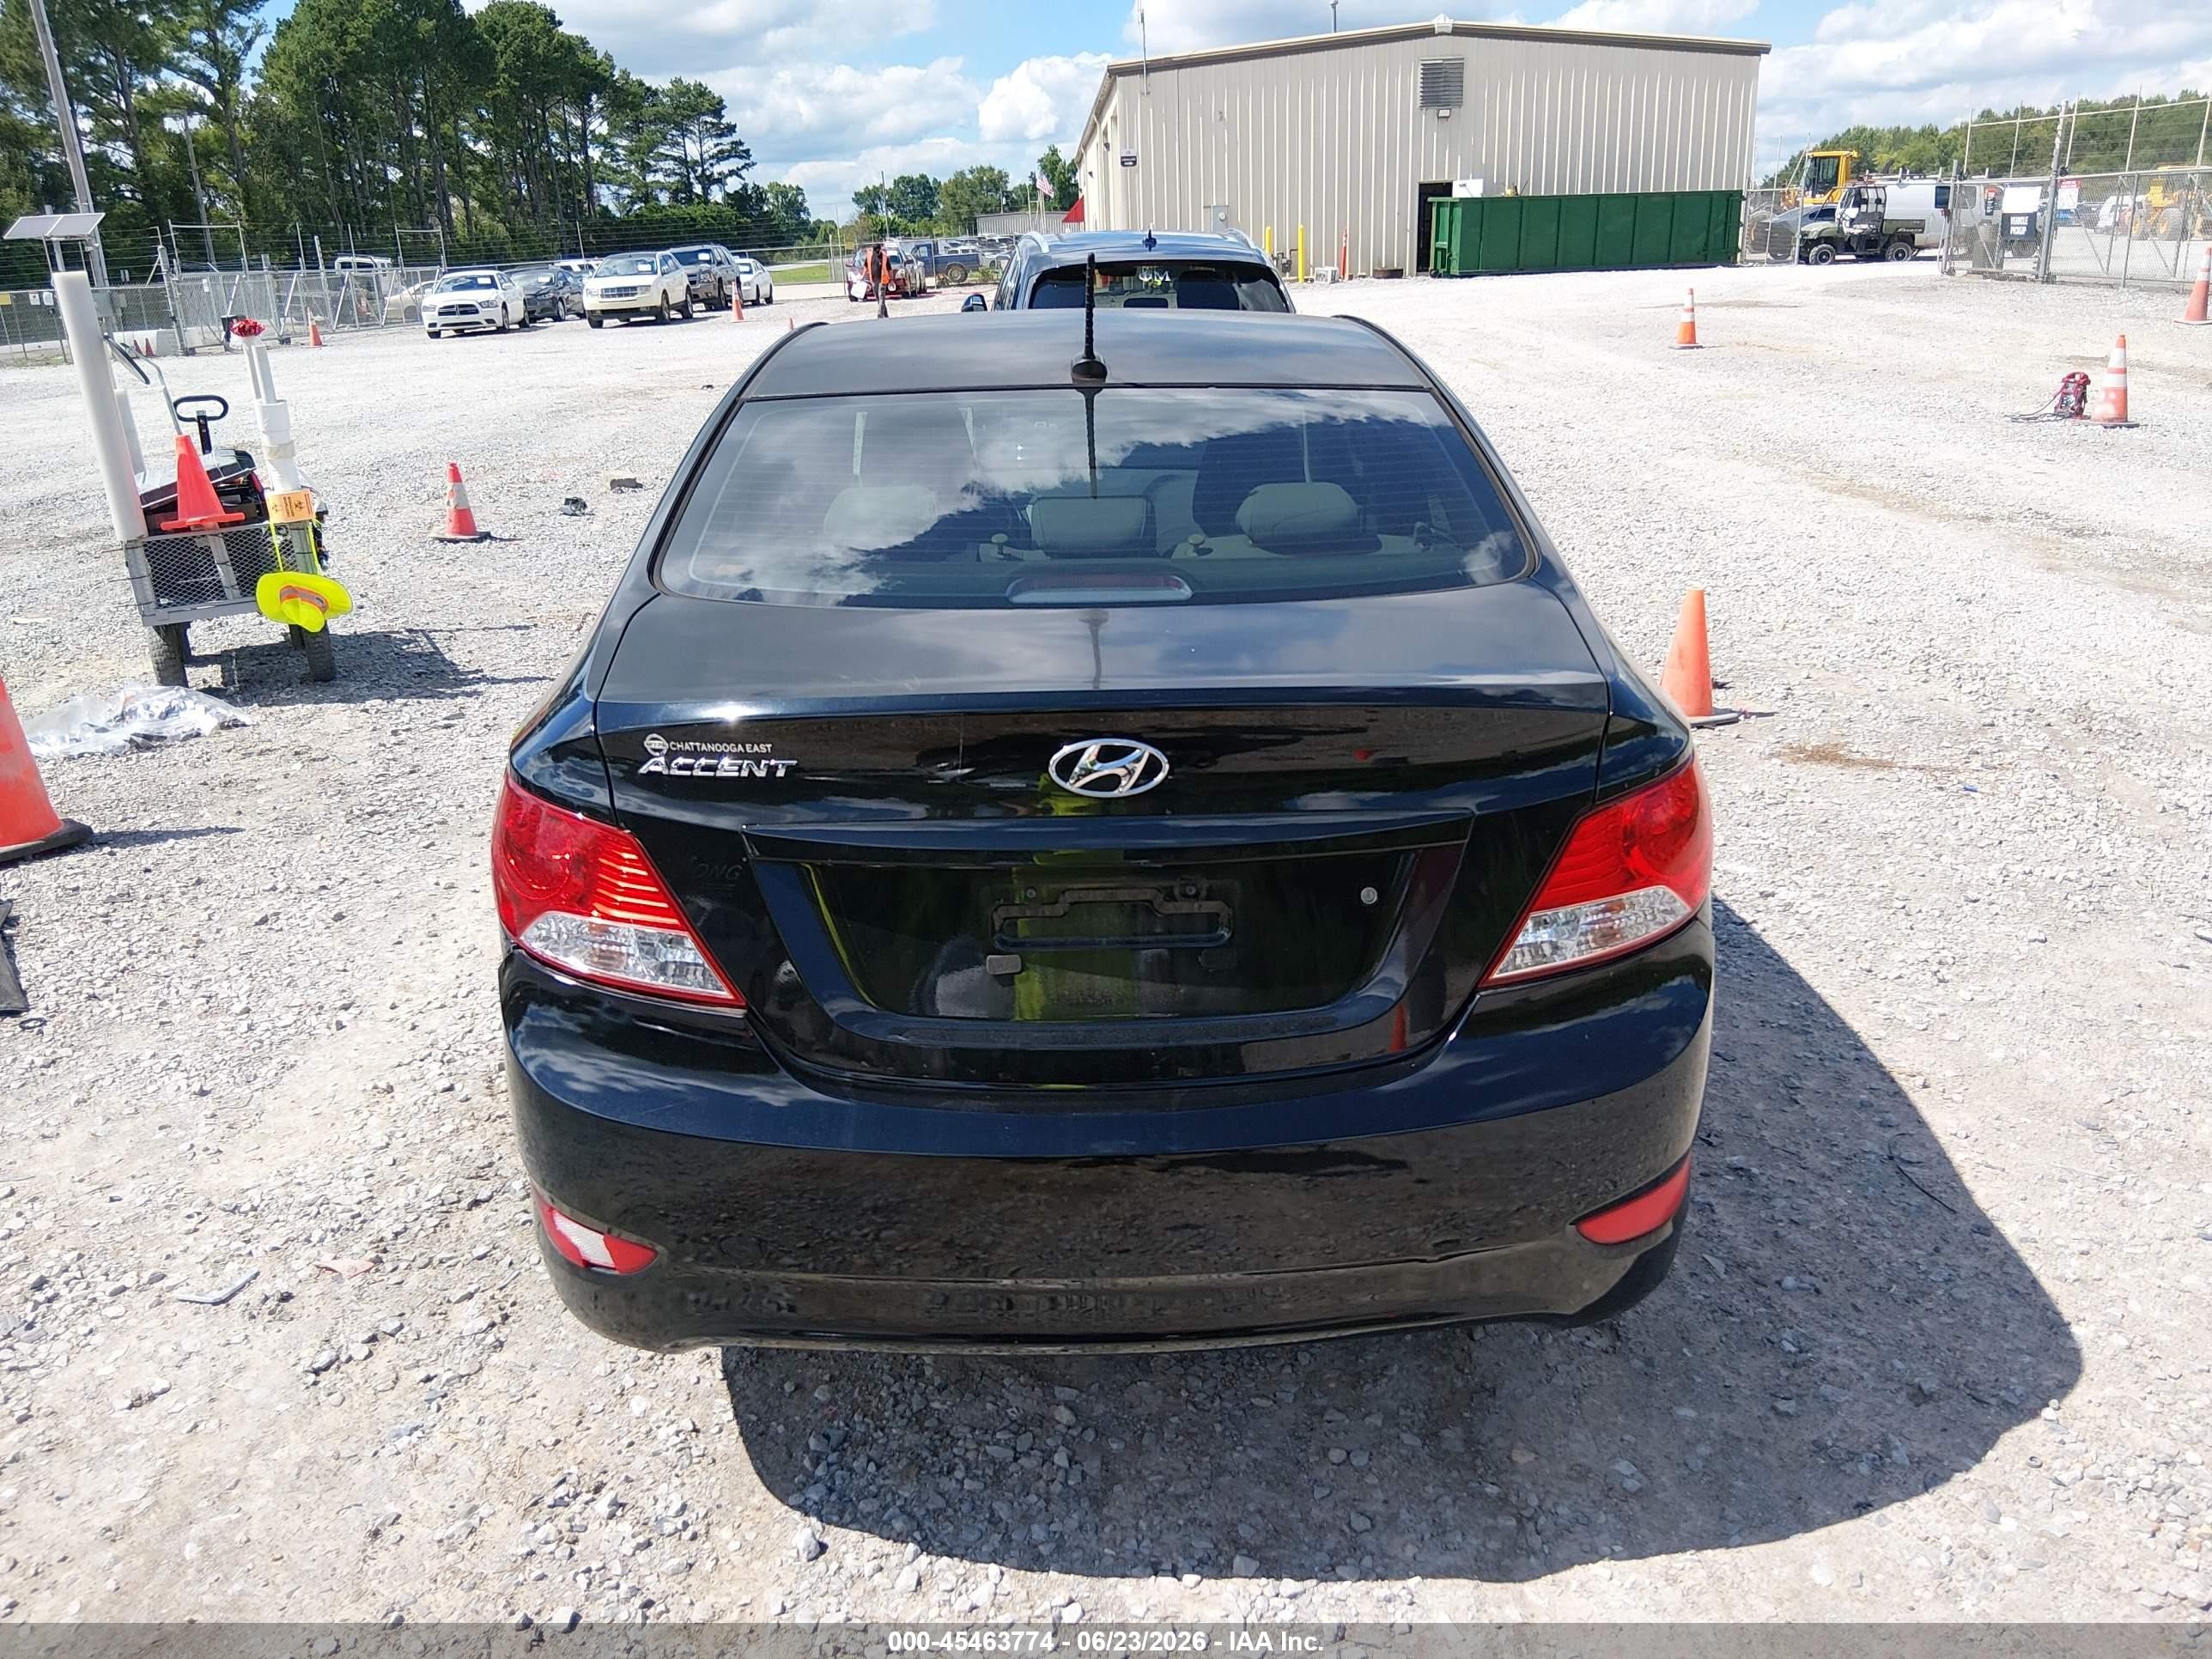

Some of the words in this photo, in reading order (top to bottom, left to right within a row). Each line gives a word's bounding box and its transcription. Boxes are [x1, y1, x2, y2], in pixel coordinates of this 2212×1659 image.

[670, 741, 746, 753] CHATTANOOGA
[745, 743, 772, 753] EAST
[637, 756, 798, 778] ACCENT
